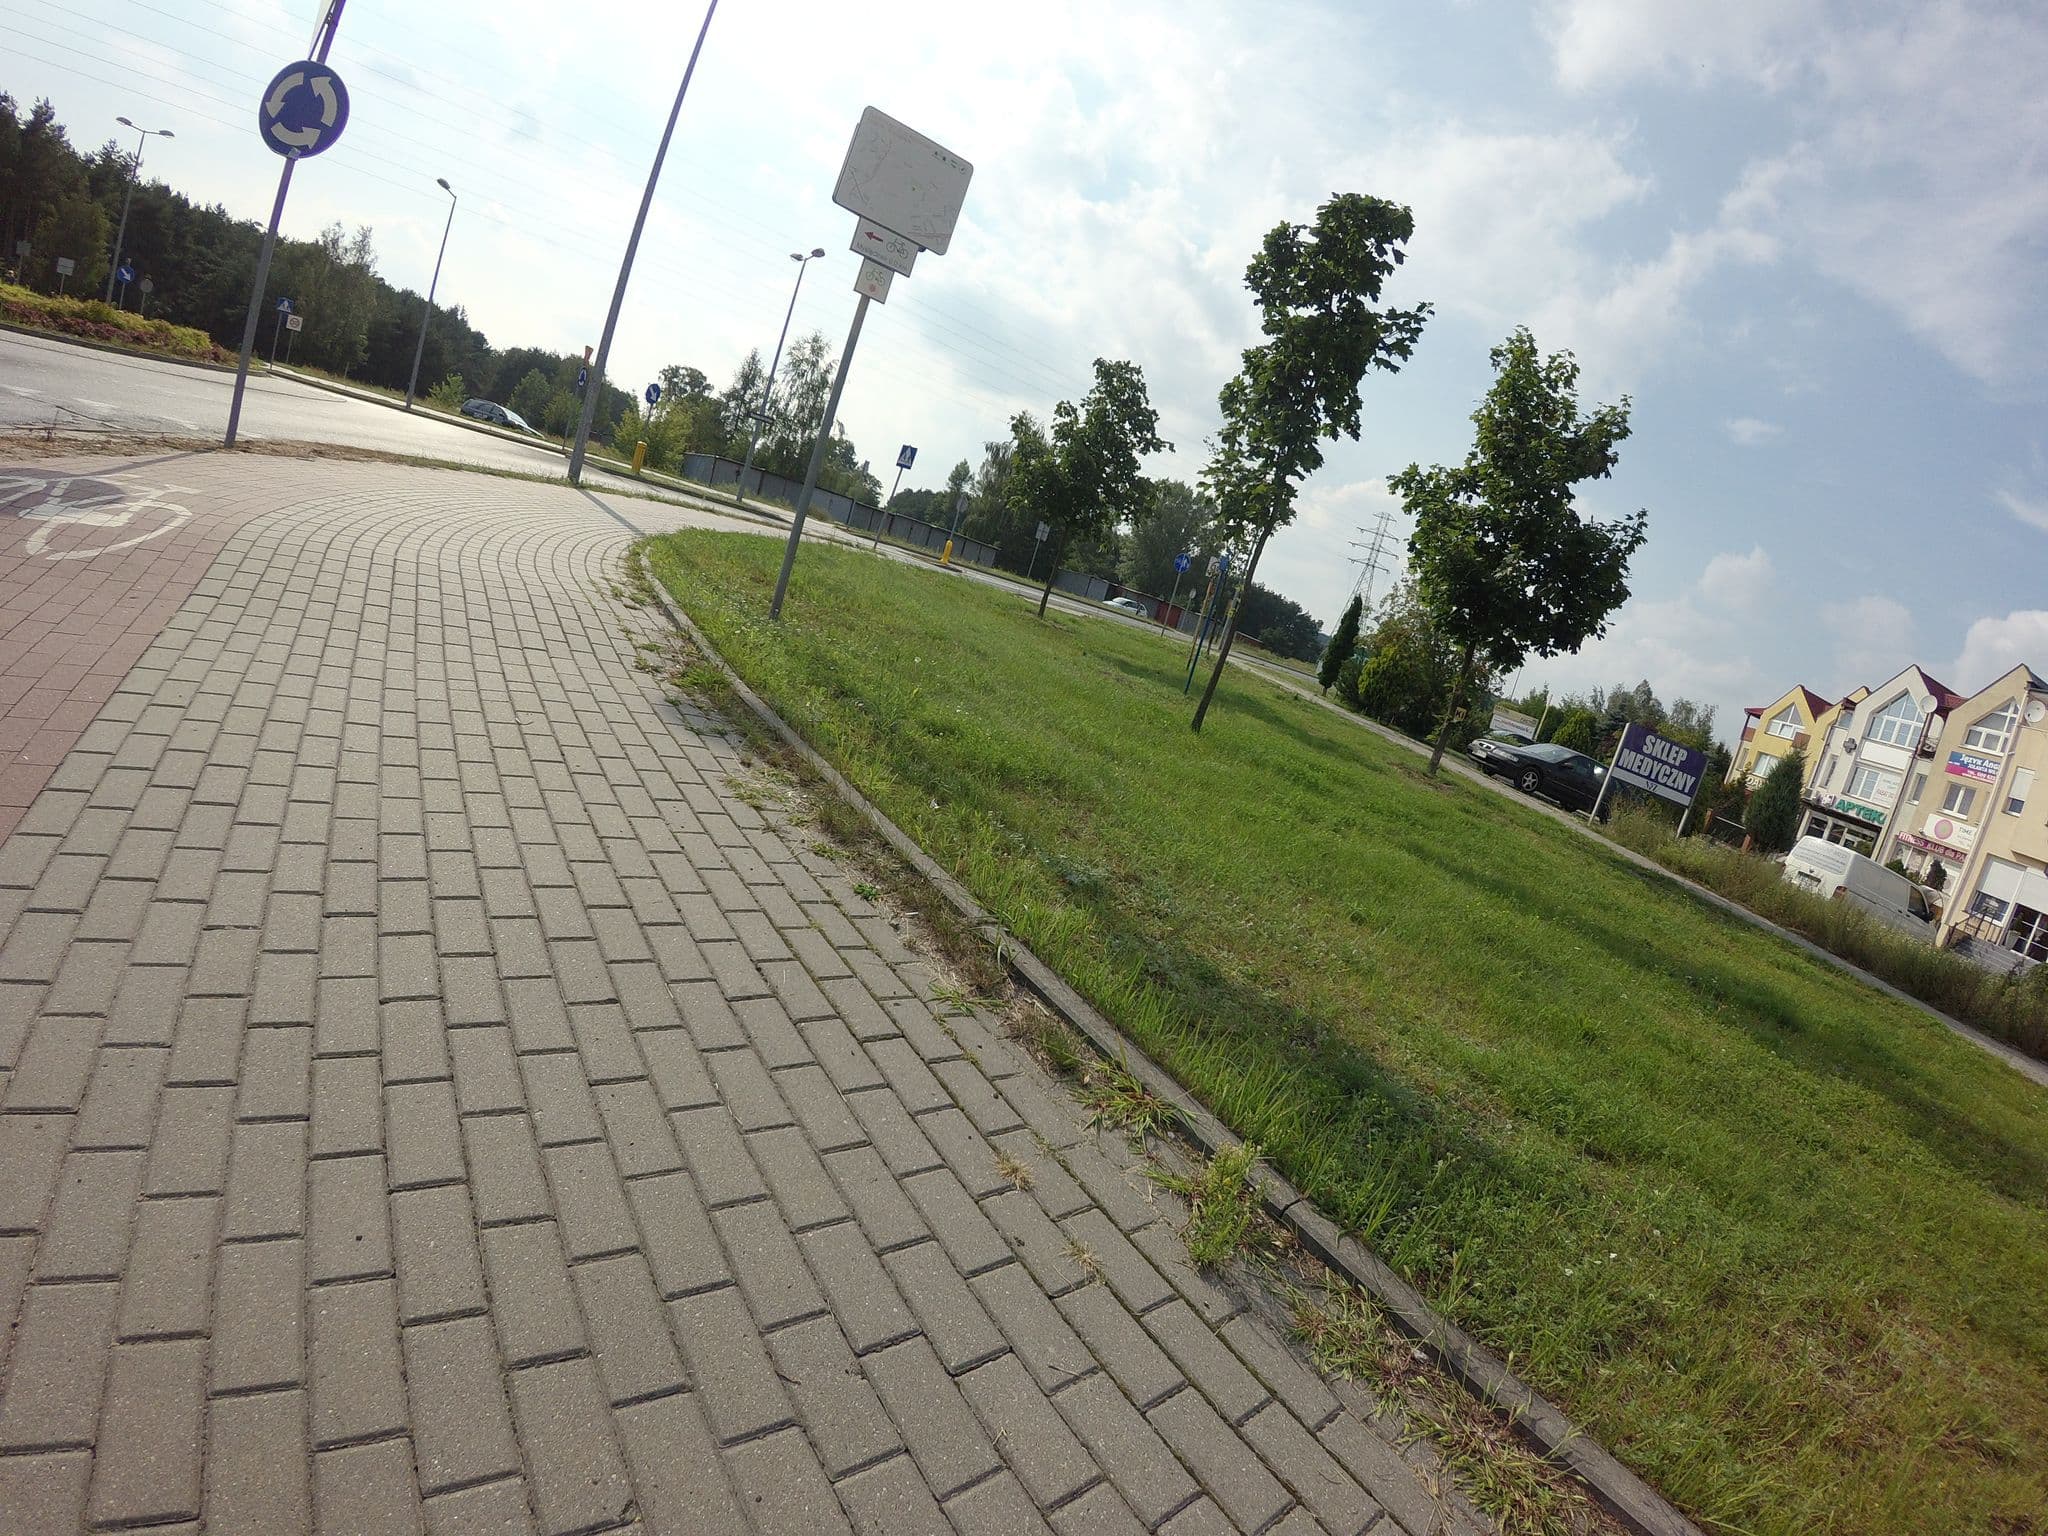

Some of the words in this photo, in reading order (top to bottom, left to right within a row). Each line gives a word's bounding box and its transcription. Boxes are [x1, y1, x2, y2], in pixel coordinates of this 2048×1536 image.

[1642, 734, 1688, 767] SKLEP
[1617, 748, 1696, 793] MEDYCZNY
[1898, 831, 1925, 847] FITNESS
[1926, 840, 1945, 855] KLUB
